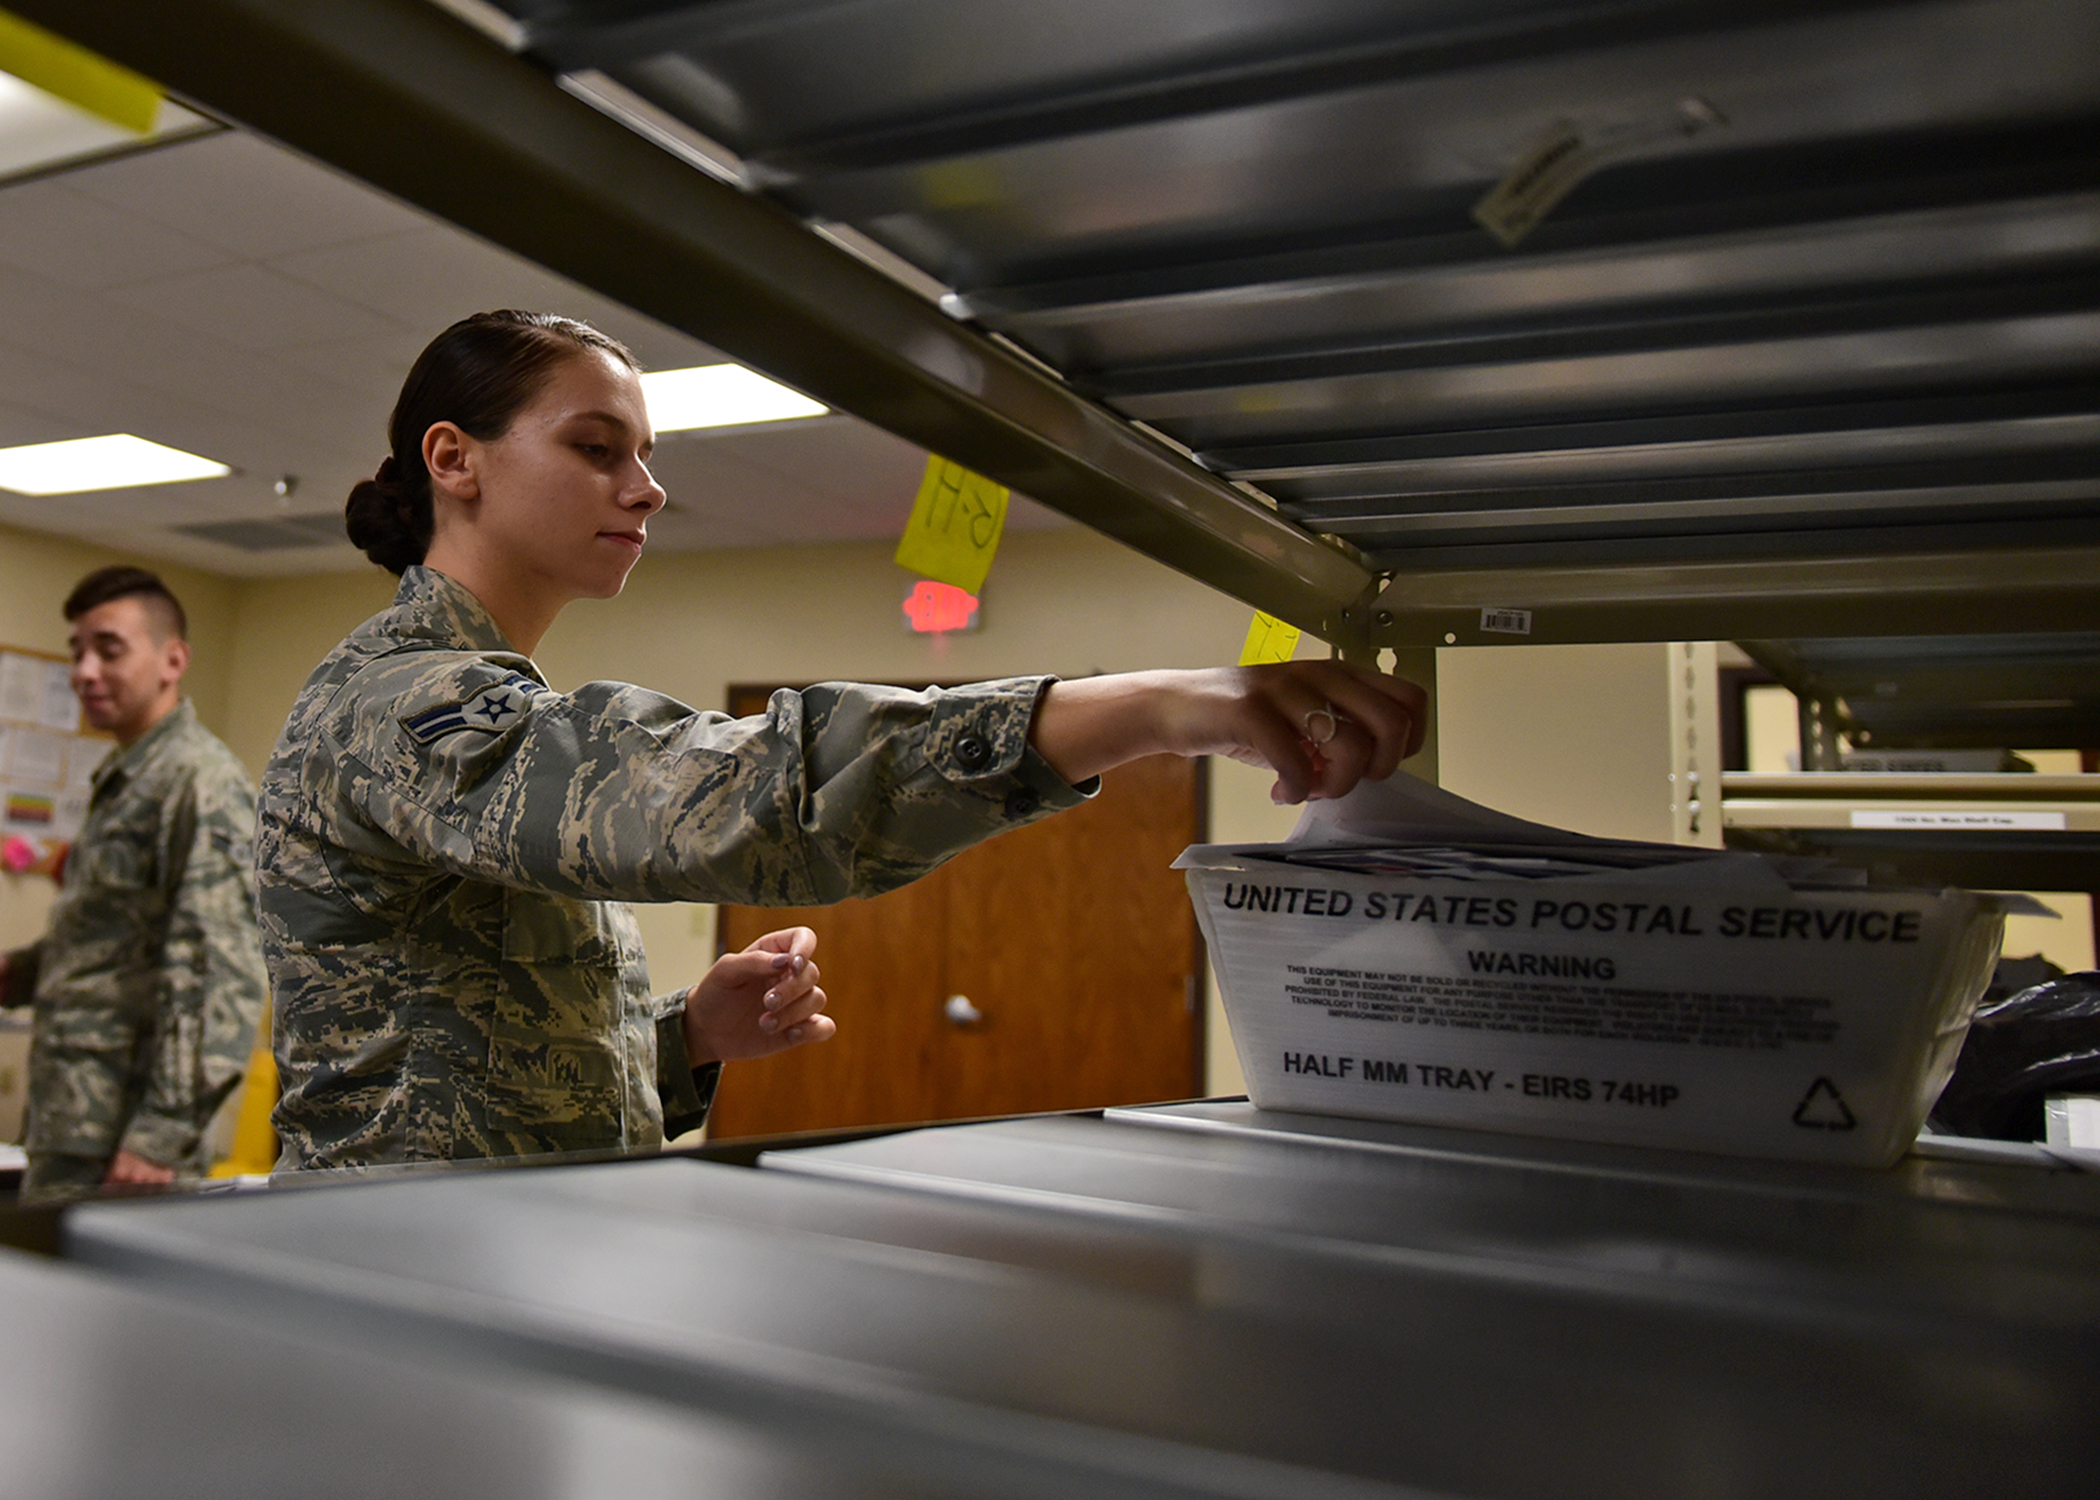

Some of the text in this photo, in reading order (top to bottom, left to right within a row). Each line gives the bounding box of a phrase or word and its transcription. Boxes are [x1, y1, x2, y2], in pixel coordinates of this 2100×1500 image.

[1223, 883, 1923, 943] UNITED STATES POSTAL SERVICE
[1467, 950, 1617, 980] WARNING
[1287, 965, 1307, 975] THIS
[1309, 967, 1362, 979] EQUIPMENT
[1365, 971, 1385, 981] MAY
[1388, 973, 1407, 983] NOT
[1410, 974, 1422, 984] BE
[1426, 976, 1453, 986] SOLD
[1455, 978, 1470, 987] OR
[1285, 985, 1340, 997] PROHIBITED
[1342, 990, 1355, 999] BY
[1357, 991, 1400, 1003] FEDERAL
[1304, 977, 1322, 986] USE
[1325, 978, 1337, 987] OF
[1340, 979, 1360, 988] THIS
[1363, 982, 1418, 993] EQUIPMENT
[1420, 986, 1440, 995] FOR
[1444, 988, 1463, 997] ANY
[1291, 995, 1354, 1009] TECHNOLOGY
[1356, 1001, 1369, 1010] TO
[1371, 1003, 1416, 1014] MONITOR
[1418, 1006, 1437, 1015] THE
[1327, 1008, 1399, 1022] IMPRISONMENT
[1401, 1014, 1415, 1024] OF
[1417, 1016, 1431, 1025] UP
[1434, 1018, 1448, 1028] TO
[1283, 1051, 1681, 1108] HALF MM TRAY - EIRS 74HP
